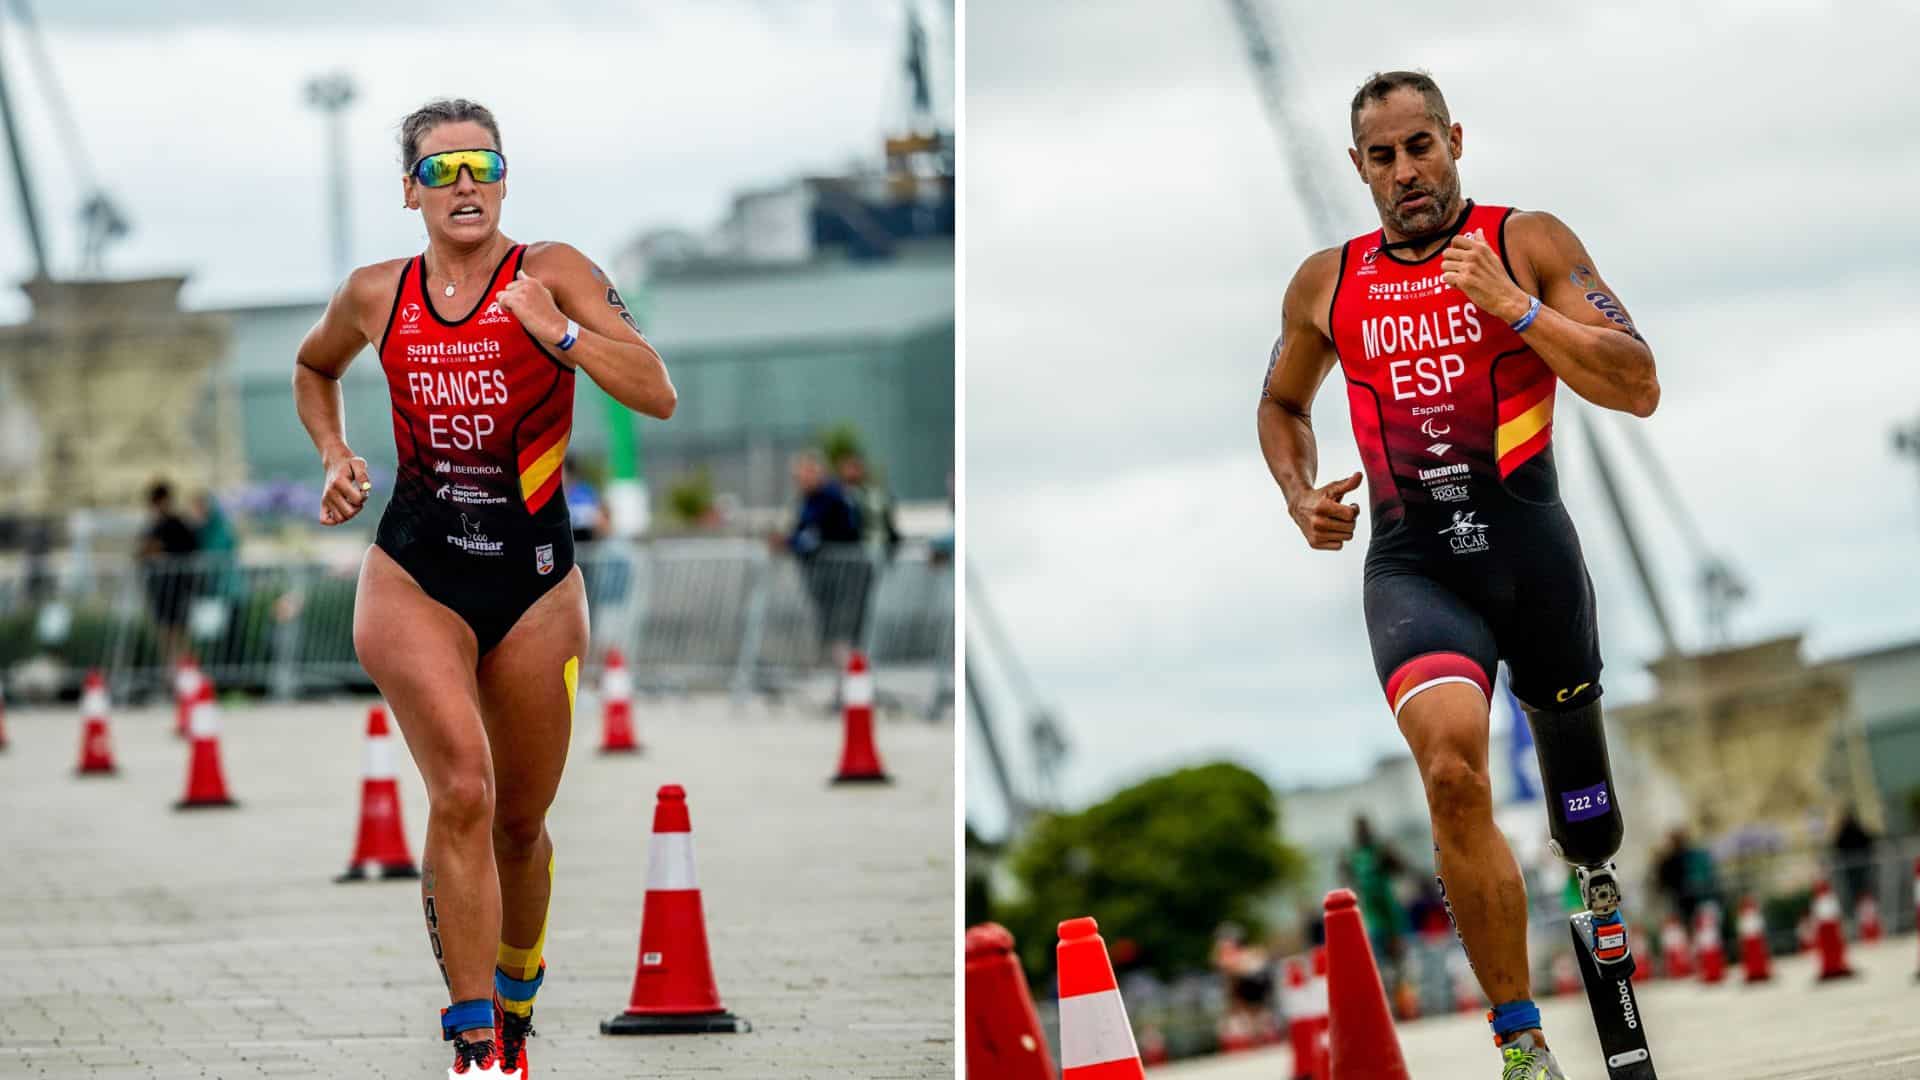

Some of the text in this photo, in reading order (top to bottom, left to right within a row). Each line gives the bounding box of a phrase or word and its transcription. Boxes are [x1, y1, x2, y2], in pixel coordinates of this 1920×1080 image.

[1361, 302, 1483, 361] MORALES
[1389, 353, 1465, 401] ESP
[408, 368, 509, 406] FRANCES
[1411, 403, 1455, 416] España
[428, 413, 495, 451] ESP
[452, 465, 503, 474] IBERDROLA
[1418, 463, 1470, 481] Lanzarote
[451, 489, 489, 498] deporte
[1431, 485, 1469, 501] sports
[447, 534, 504, 551] rujamar
[1449, 533, 1489, 550] CICAR
[1568, 796, 1592, 812] 222
[1617, 979, 1638, 1029] ottoboc
